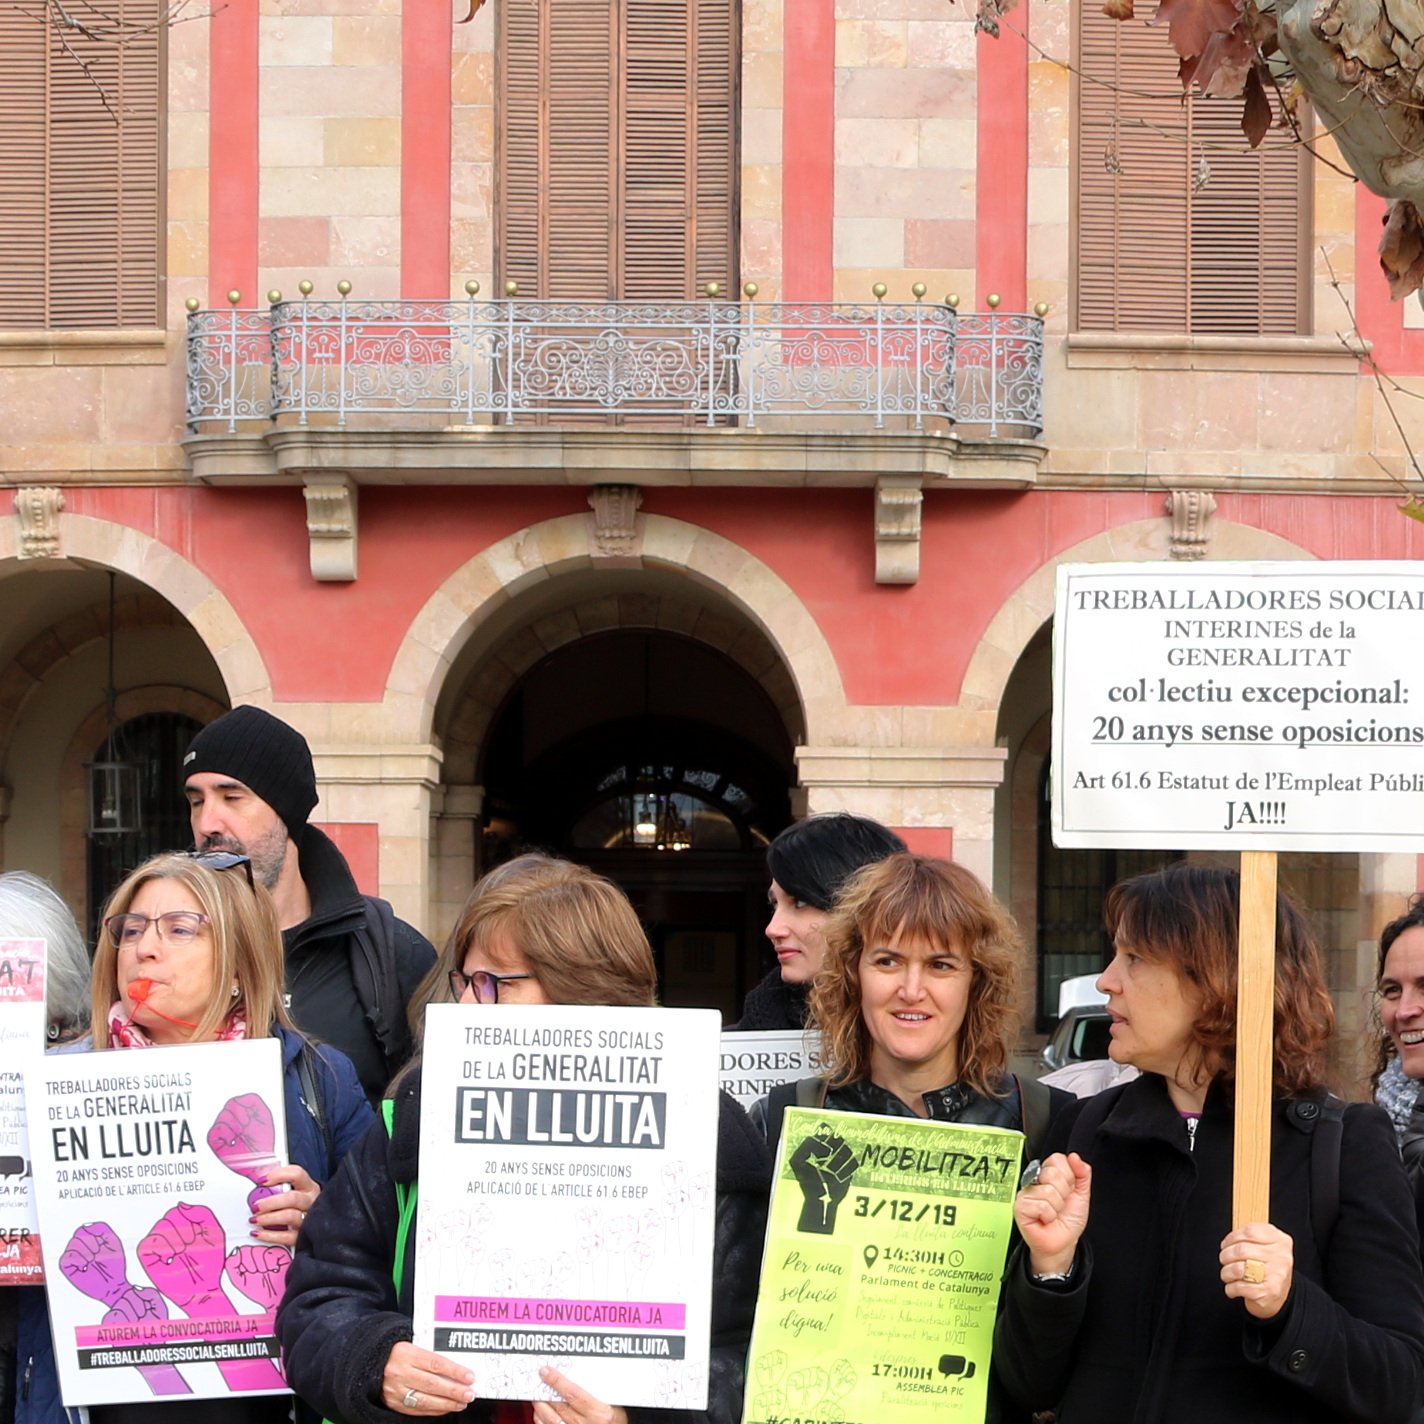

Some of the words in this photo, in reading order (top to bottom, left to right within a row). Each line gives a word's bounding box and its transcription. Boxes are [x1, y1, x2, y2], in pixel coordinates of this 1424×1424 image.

[1075, 590, 1322, 611] TREBALLADORES
[1164, 620, 1303, 639] INTERINES
[1309, 620, 1333, 639] de
[1339, 620, 1356, 639] la
[1167, 648, 1352, 667] GENERALITAT
[1241, 679, 1409, 710] excepcional:
[1091, 716, 1124, 741] 20
[1132, 723, 1194, 747] anys
[1201, 722, 1273, 742] sense
[1282, 718, 1424, 749] oposicions
[1073, 771, 1105, 790] Art
[1111, 771, 1151, 790] 61.6
[1157, 771, 1229, 791] Estatut
[1235, 771, 1259, 791] de
[1224, 802, 1287, 831] JA!!!!
[465, 1027, 592, 1048] TREBALLADORES
[598, 1031, 664, 1050] SOCIALS
[463, 1061, 482, 1079] DE
[488, 1062, 506, 1079] LA
[512, 1053, 662, 1084] GENERALITAT
[46, 1076, 140, 1095] TREBALLADORES
[143, 1072, 192, 1089] SOCIALS
[48, 1106, 63, 1120] DE
[66, 1105, 80, 1119] LA
[84, 1091, 192, 1118] GENERALITAT
[462, 1090, 512, 1140] EN
[527, 1092, 660, 1145] LLUITA
[52, 1126, 89, 1161] EN
[99, 1119, 196, 1159] LLUITA
[56, 1170, 68, 1182] 20
[72, 1168, 98, 1181] ANYS
[101, 1166, 134, 1180] SENSE
[137, 1161, 199, 1177] OPOSICIONS
[484, 1161, 497, 1174] 20
[501, 1162, 528, 1174] ANYS
[532, 1163, 565, 1176] SENSE
[569, 1164, 632, 1177] OPOSICIONS
[860, 1145, 1015, 1183] MOBILITZA'T
[13, 1186, 28, 1195] PIC
[59, 1185, 103, 1199] APLICACIÓ
[105, 1186, 116, 1197] DE
[163, 1182, 181, 1193] 61.6
[183, 1180, 205, 1192] EBEP
[467, 1180, 521, 1195] APLICACIÓ
[525, 1183, 538, 1195] DE
[596, 1185, 617, 1197] 61.6
[621, 1186, 648, 1198] EBEP
[855, 1195, 956, 1226] 3/12/19
[861, 1274, 918, 1289] Parlament
[922, 1281, 935, 1290] de
[939, 1282, 990, 1296] Catalunya
[454, 1301, 508, 1319] ATUREM
[514, 1303, 530, 1320] LA
[536, 1304, 641, 1323] CONVOCATORIA
[645, 1307, 662, 1324] JA
[97, 1327, 140, 1342] ATUREM
[143, 1326, 157, 1339] LA
[160, 1320, 241, 1338] CONVOCATÒRIA
[245, 1320, 258, 1333] JA
[91, 1342, 268, 1367] #TREBALLADORESSOCIALSENLLUITA
[448, 1331, 670, 1355] #TREBALLADORESSOCIALSENLLUITA
